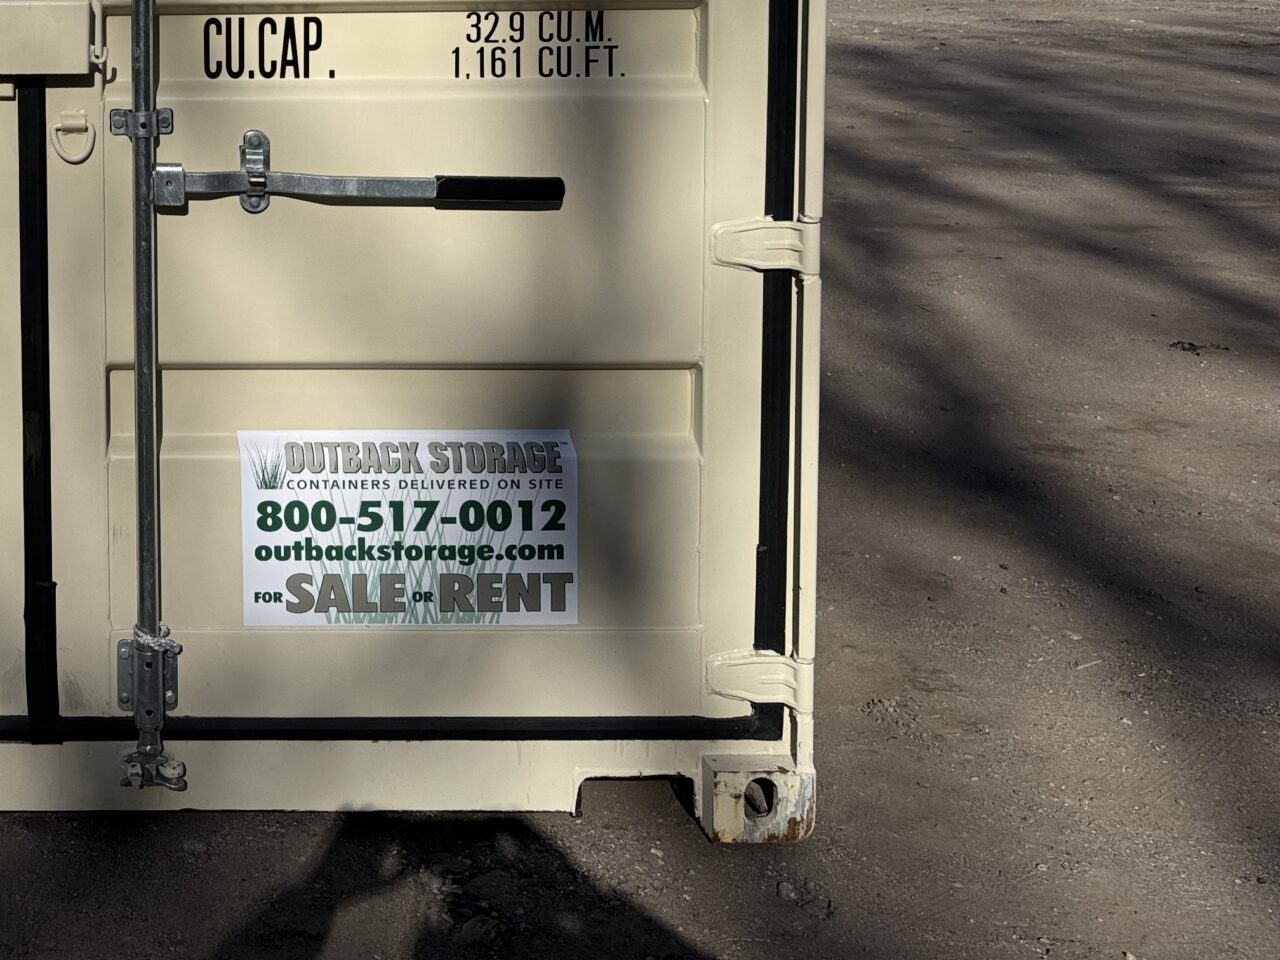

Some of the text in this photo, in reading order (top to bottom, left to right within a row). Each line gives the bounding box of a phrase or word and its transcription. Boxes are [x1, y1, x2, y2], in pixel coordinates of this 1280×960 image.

[203, 10, 612, 79] CU.CAP. 32.9 CU.M.
[451, 45, 626, 79] 1,161 CU.FT.
[284, 441, 423, 474] OUTBACK
[286, 478, 564, 490] CONTAINERS DELIVERED ON SITE
[256, 499, 567, 533] 800-517-0012
[254, 537, 565, 566] outbackstorage.com
[254, 572, 574, 614] FOR SALE OR RENT
